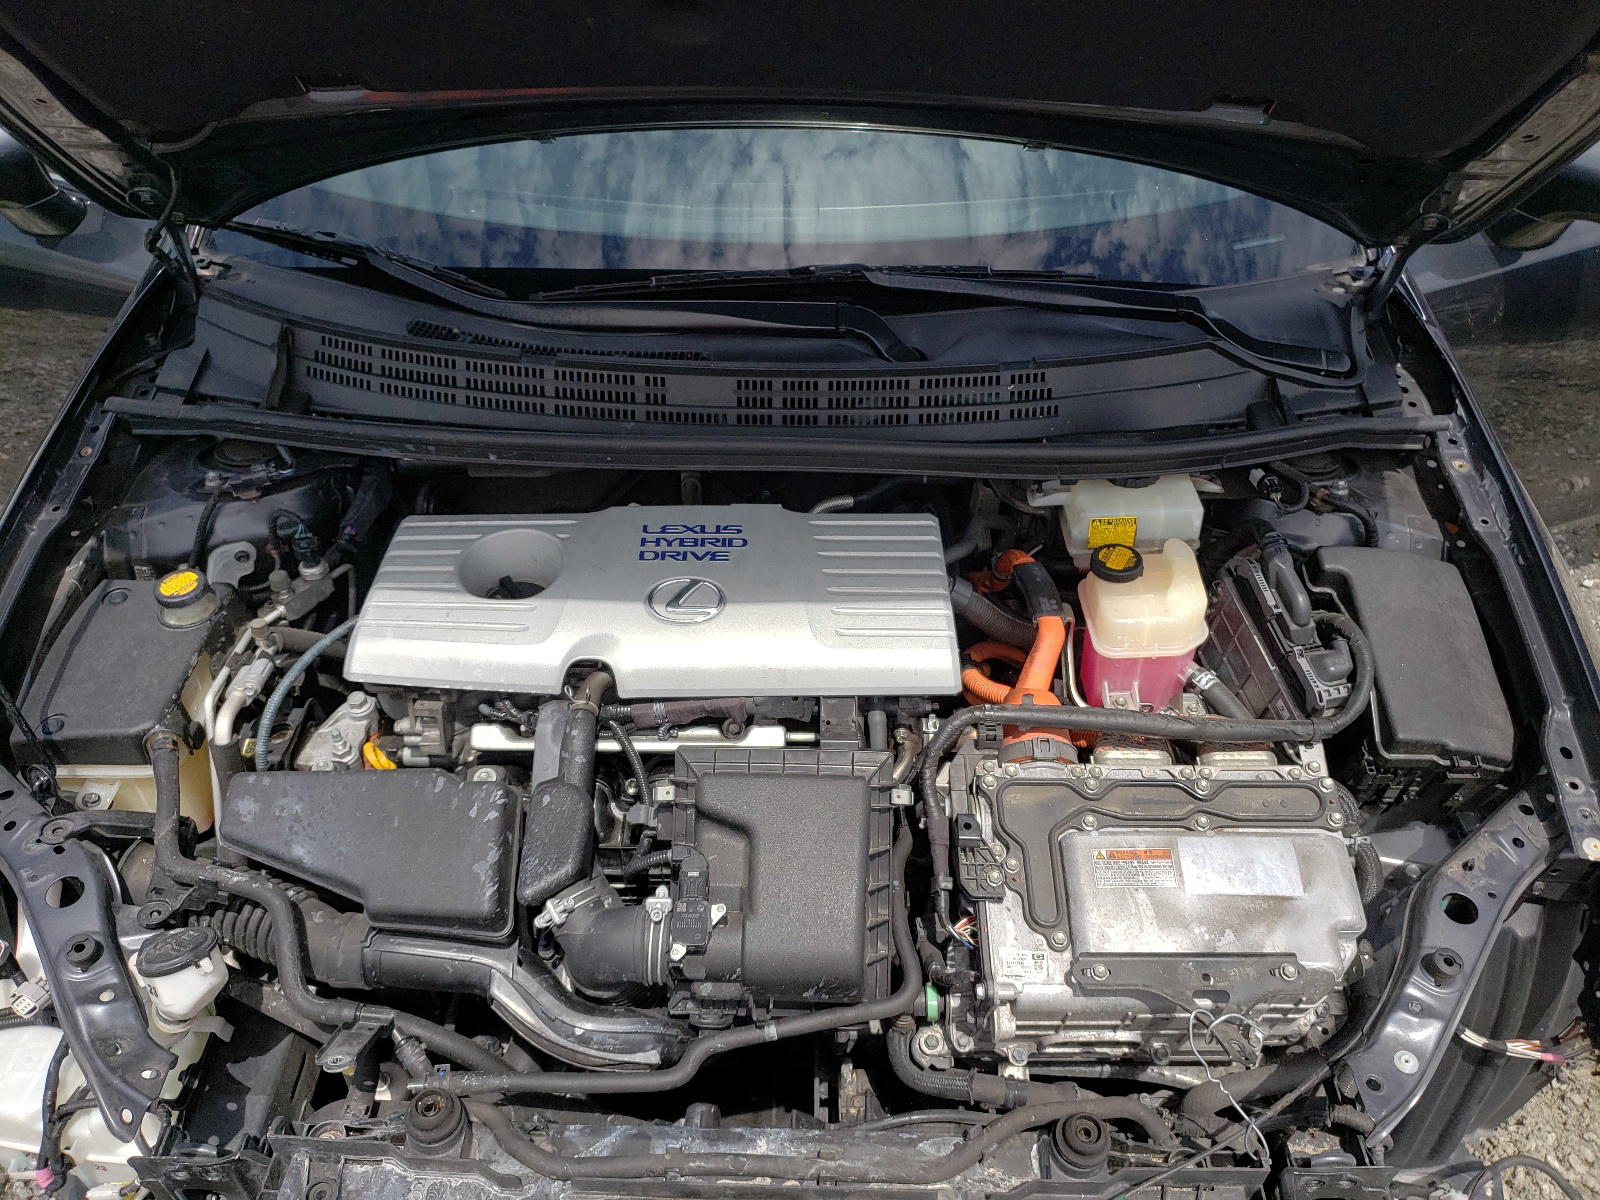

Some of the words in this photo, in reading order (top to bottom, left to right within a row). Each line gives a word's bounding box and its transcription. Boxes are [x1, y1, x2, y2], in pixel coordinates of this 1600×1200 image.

[642, 524, 743, 535] LEXUS
[640, 537, 748, 548] HYBRID
[638, 550, 731, 561] DRIVE
